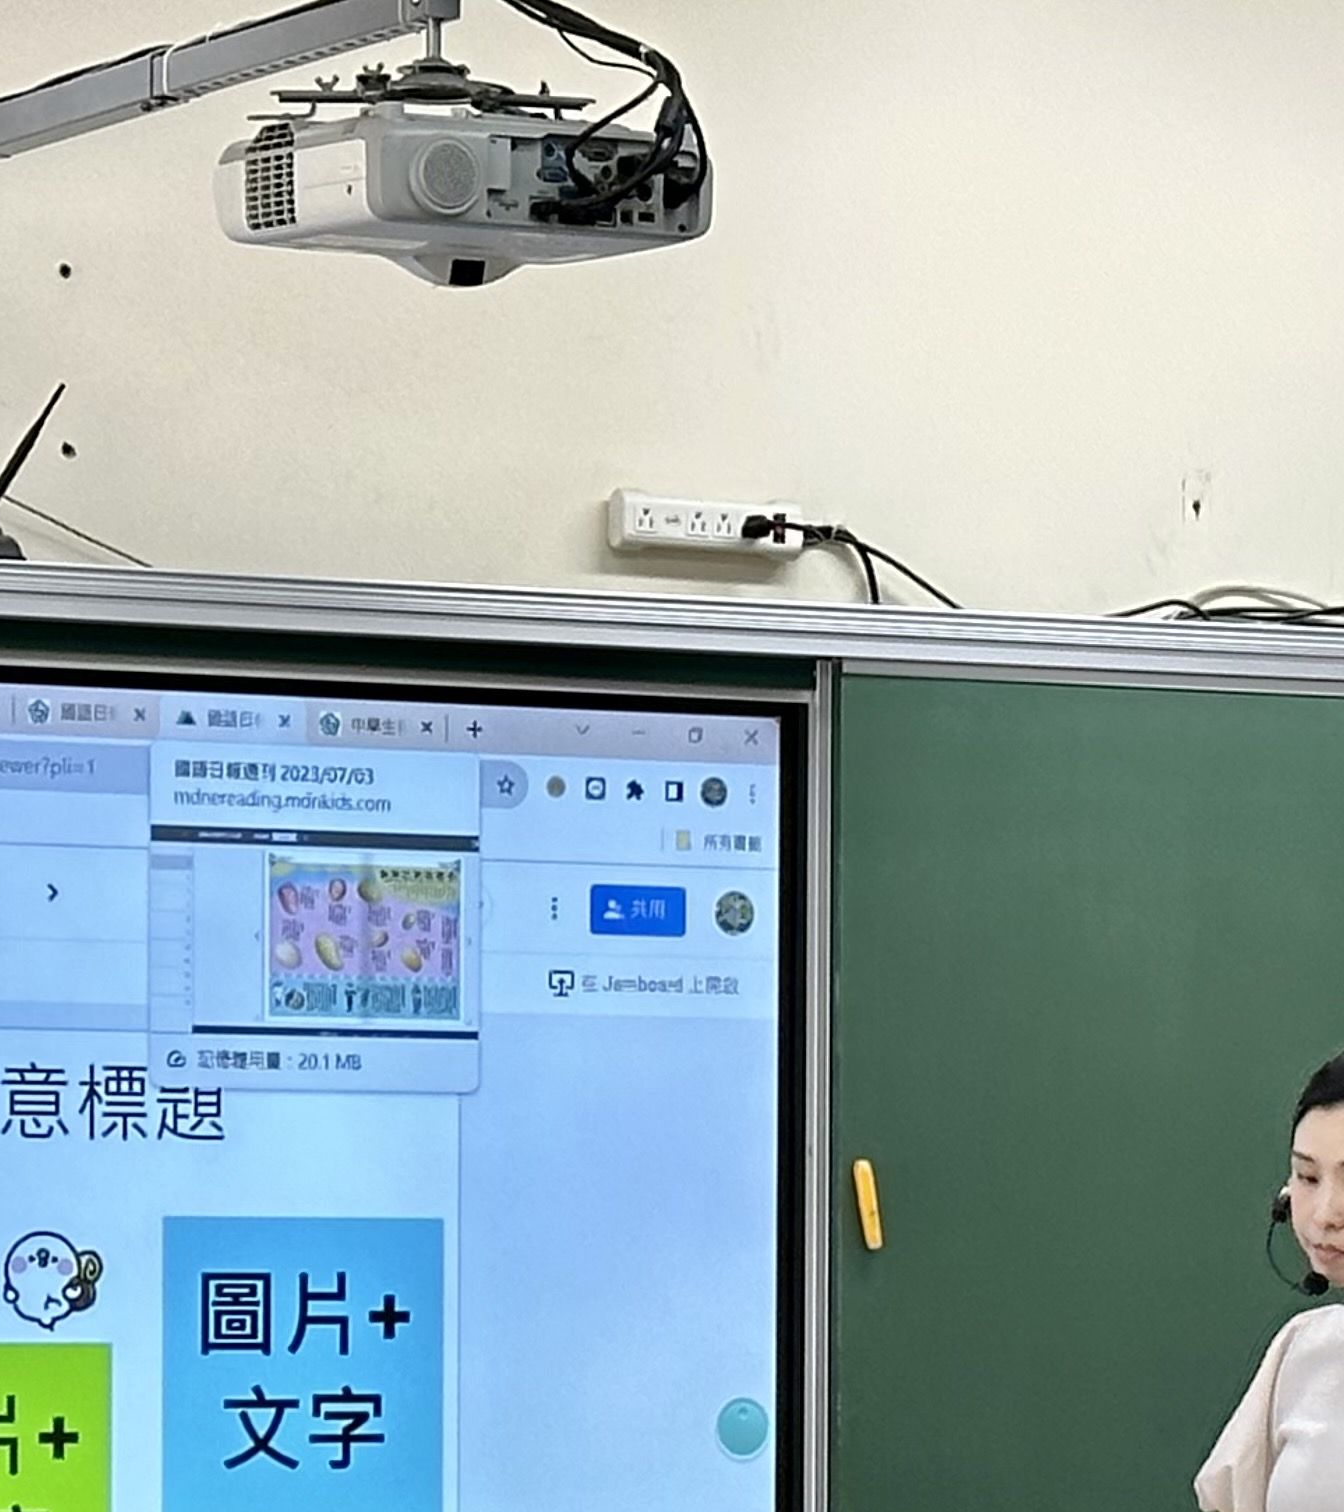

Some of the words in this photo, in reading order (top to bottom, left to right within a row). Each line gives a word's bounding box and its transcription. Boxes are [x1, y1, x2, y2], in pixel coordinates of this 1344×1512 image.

[280, 766, 374, 785] 2023/07/03
[201, 1272, 411, 1356] 圖片+
[223, 1386, 385, 1470] 文字
